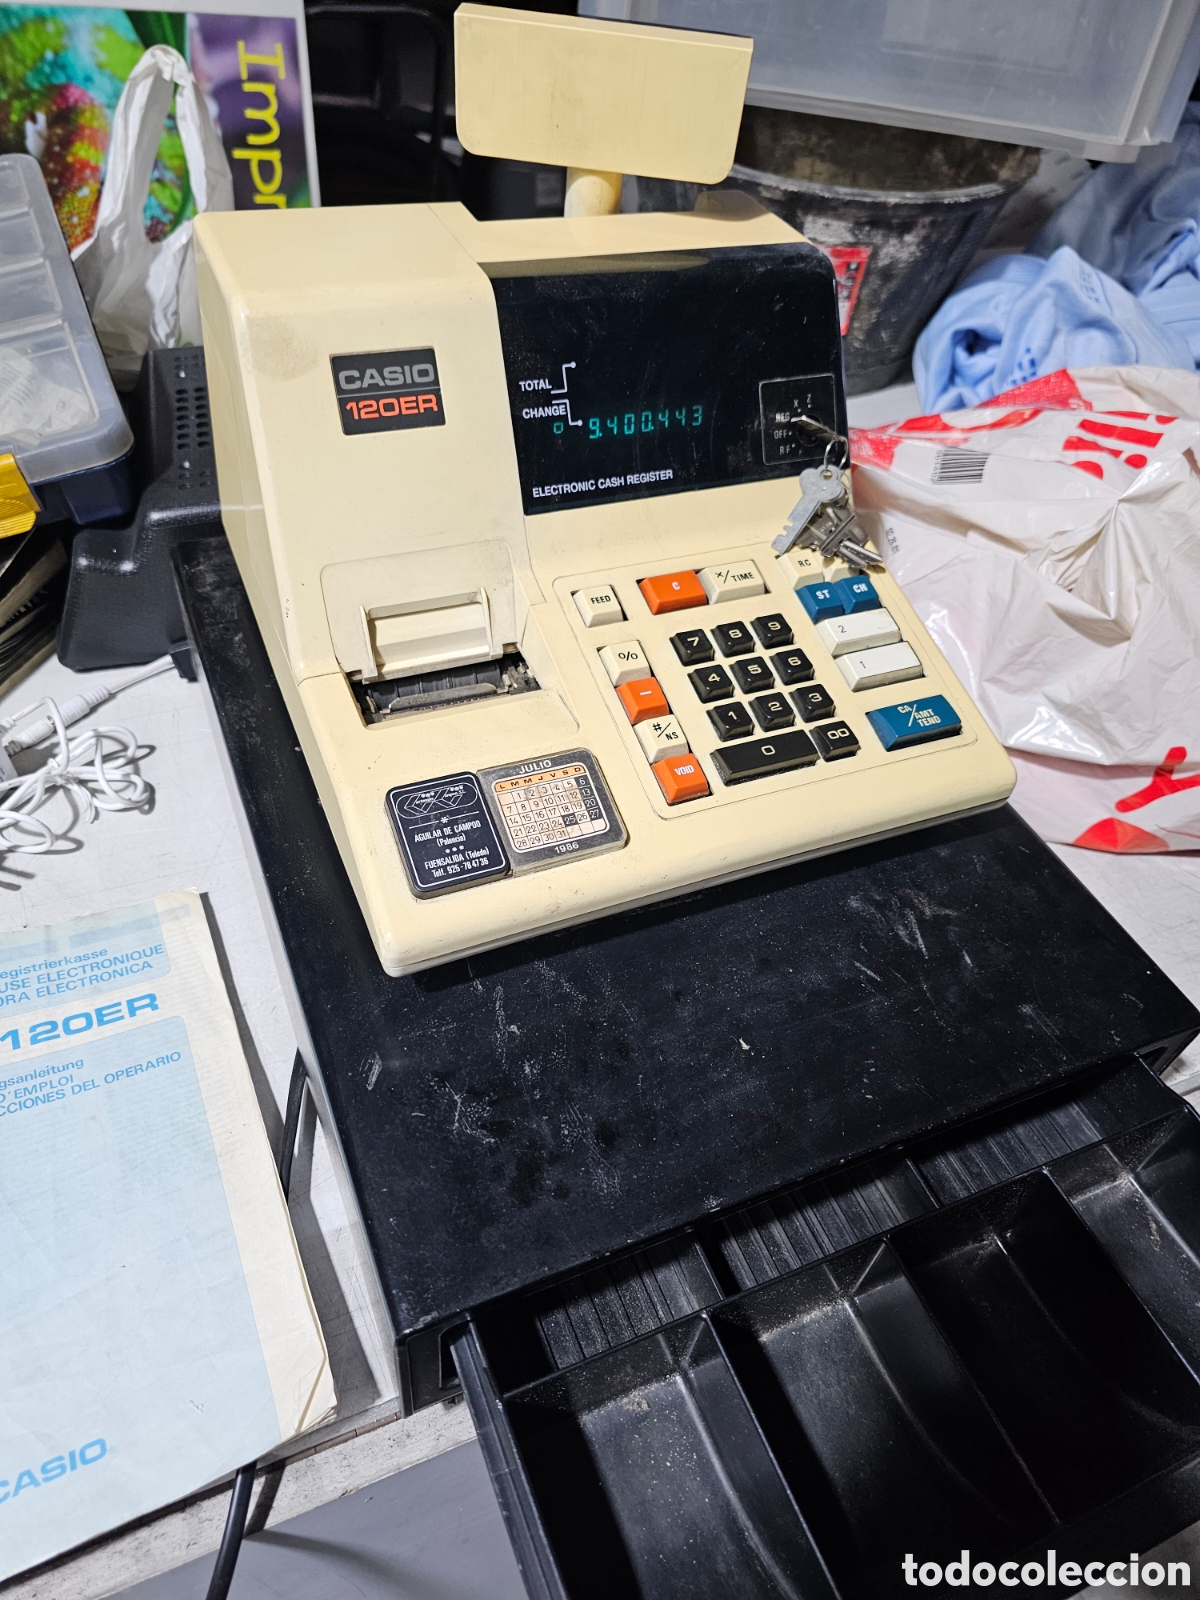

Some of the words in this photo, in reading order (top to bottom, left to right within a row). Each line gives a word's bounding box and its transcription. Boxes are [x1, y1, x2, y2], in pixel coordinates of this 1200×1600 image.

[338, 363, 435, 390] CASIO
[519, 379, 552, 391] TOTAL
[345, 394, 438, 420] 120ER
[522, 405, 566, 419] CHANGE
[774, 430, 787, 440] OFF
[532, 480, 596, 498] ELECTRONIC
[598, 476, 624, 489] CASH
[626, 469, 673, 485] REGISTER
[672, 582, 680, 591] C
[815, 589, 830, 600] ST
[852, 583, 868, 593] CH
[590, 595, 611, 604] FEED
[687, 636, 699, 646] 7
[728, 629, 742, 638] 8
[768, 621, 781, 630] 9
[838, 625, 847, 634] 2
[708, 673, 720, 682] 4
[747, 664, 762, 674] 5
[787, 657, 801, 666] 6
[859, 661, 866, 669] 1
[728, 711, 737, 720] 1
[768, 701, 782, 711] 2
[808, 692, 823, 702] 3
[916, 716, 941, 727] TEND
[519, 760, 552, 774] JULIO
[674, 765, 694, 776] VOID
[544, 797, 554, 805] 10
[570, 791, 578, 799] 12
[582, 788, 590, 796] 13
[522, 814, 531, 822] 15
[535, 811, 544, 819] 16
[573, 802, 582, 810] 19
[585, 799, 596, 807] 20
[513, 828, 522, 836] 21
[538, 822, 550, 830] 23
[552, 819, 562, 827] 24
[564, 816, 576, 825] 25
[577, 813, 588, 821] 26
[590, 810, 600, 818] 27
[414, 830, 442, 843] AGUILAR
[443, 827, 452, 835] DE
[517, 839, 527, 848] 28
[530, 836, 541, 844] 29
[545, 833, 554, 841] 30
[557, 830, 566, 838] 31
[555, 842, 579, 854] 1986
[424, 853, 464, 870] FUENSALIDA
[37, 944, 164, 985] ELECTRONIQUE
[36, 960, 153, 999] ELECTRONICA
[0, 992, 159, 1051] 120ER
[71, 1078, 100, 1096] DEL
[104, 1051, 182, 1084] OPERARIO
